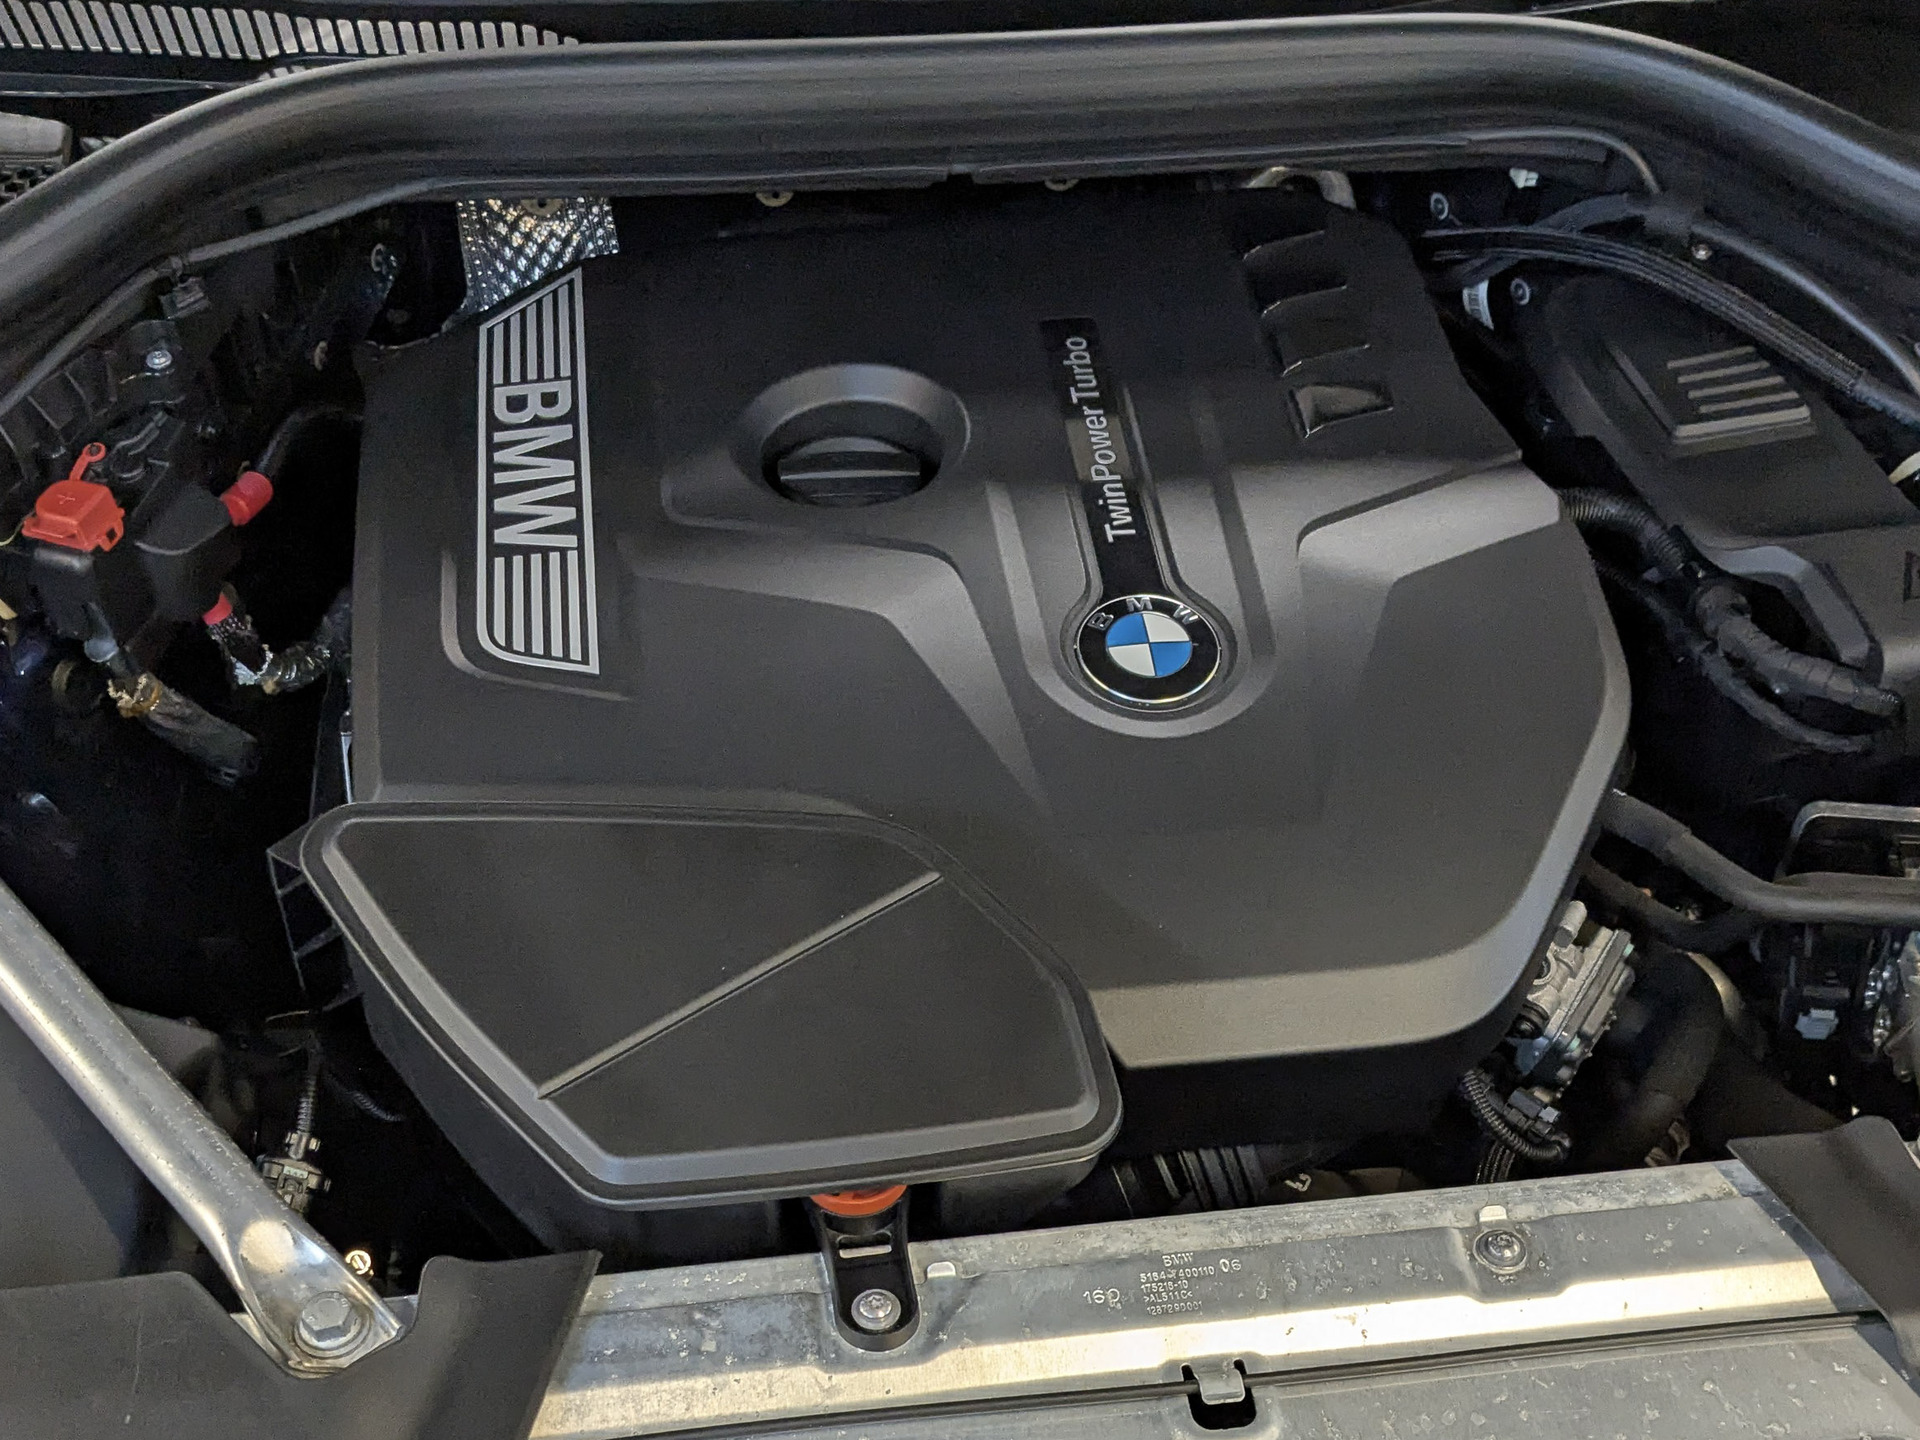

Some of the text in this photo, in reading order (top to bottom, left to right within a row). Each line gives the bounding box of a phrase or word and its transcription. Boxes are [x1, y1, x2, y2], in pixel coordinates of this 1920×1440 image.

[493, 379, 578, 548] BMW
[1064, 336, 1137, 544] TwinPower Turbo
[1089, 596, 1199, 631] BMW
[1162, 1252, 1194, 1267] BMW
